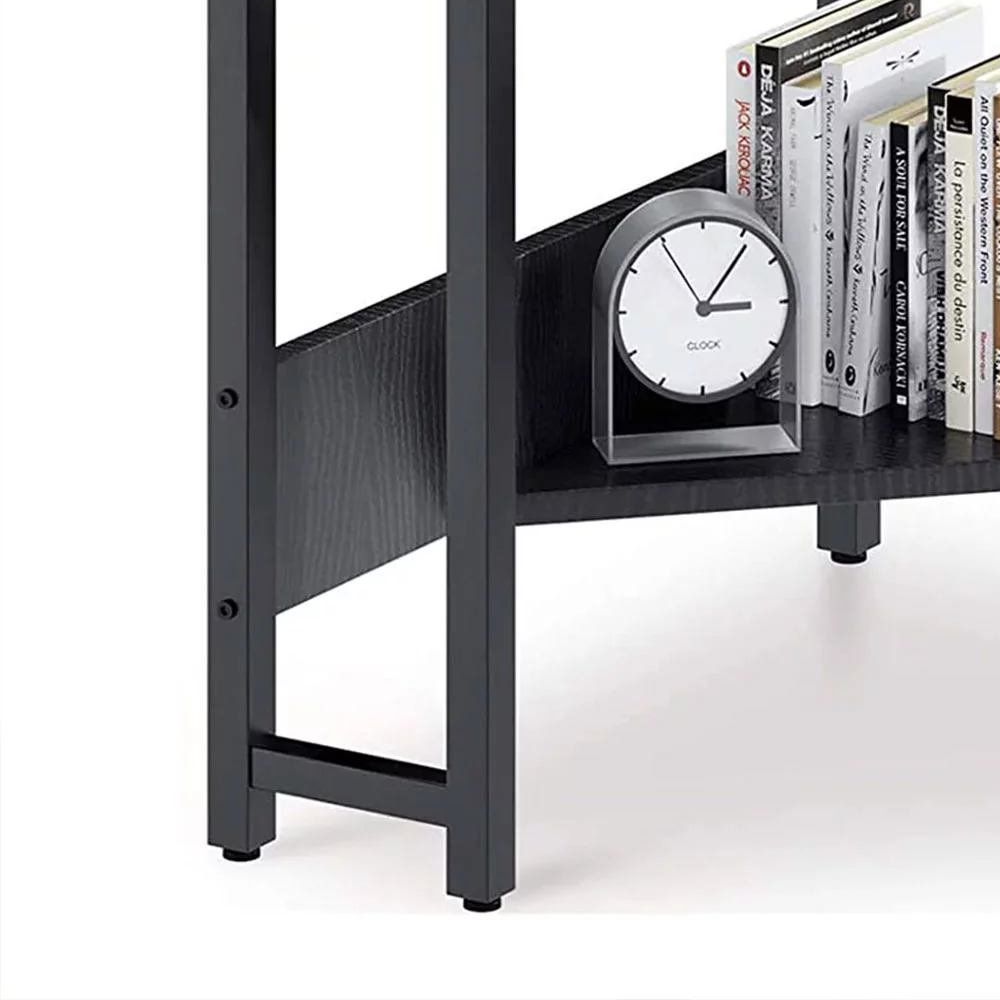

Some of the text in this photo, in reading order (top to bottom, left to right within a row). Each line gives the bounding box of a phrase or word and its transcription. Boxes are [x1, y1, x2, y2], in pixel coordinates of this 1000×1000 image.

[826, 75, 834, 94] The
[734, 99, 751, 196] JACK KEROUAC
[863, 133, 872, 150] The
[760, 125, 774, 200] KARMA
[896, 159, 907, 191] SOUL
[896, 192, 907, 217] FOR
[933, 163, 946, 233] KARMA
[979, 96, 989, 284] All Quiet on the Western Front
[896, 218, 907, 251] SALE
[951, 182, 966, 267] persistance
[953, 272, 967, 292] du
[896, 281, 907, 323] CAROL
[953, 298, 967, 341] destin
[687, 340, 721, 351] CLOCK
